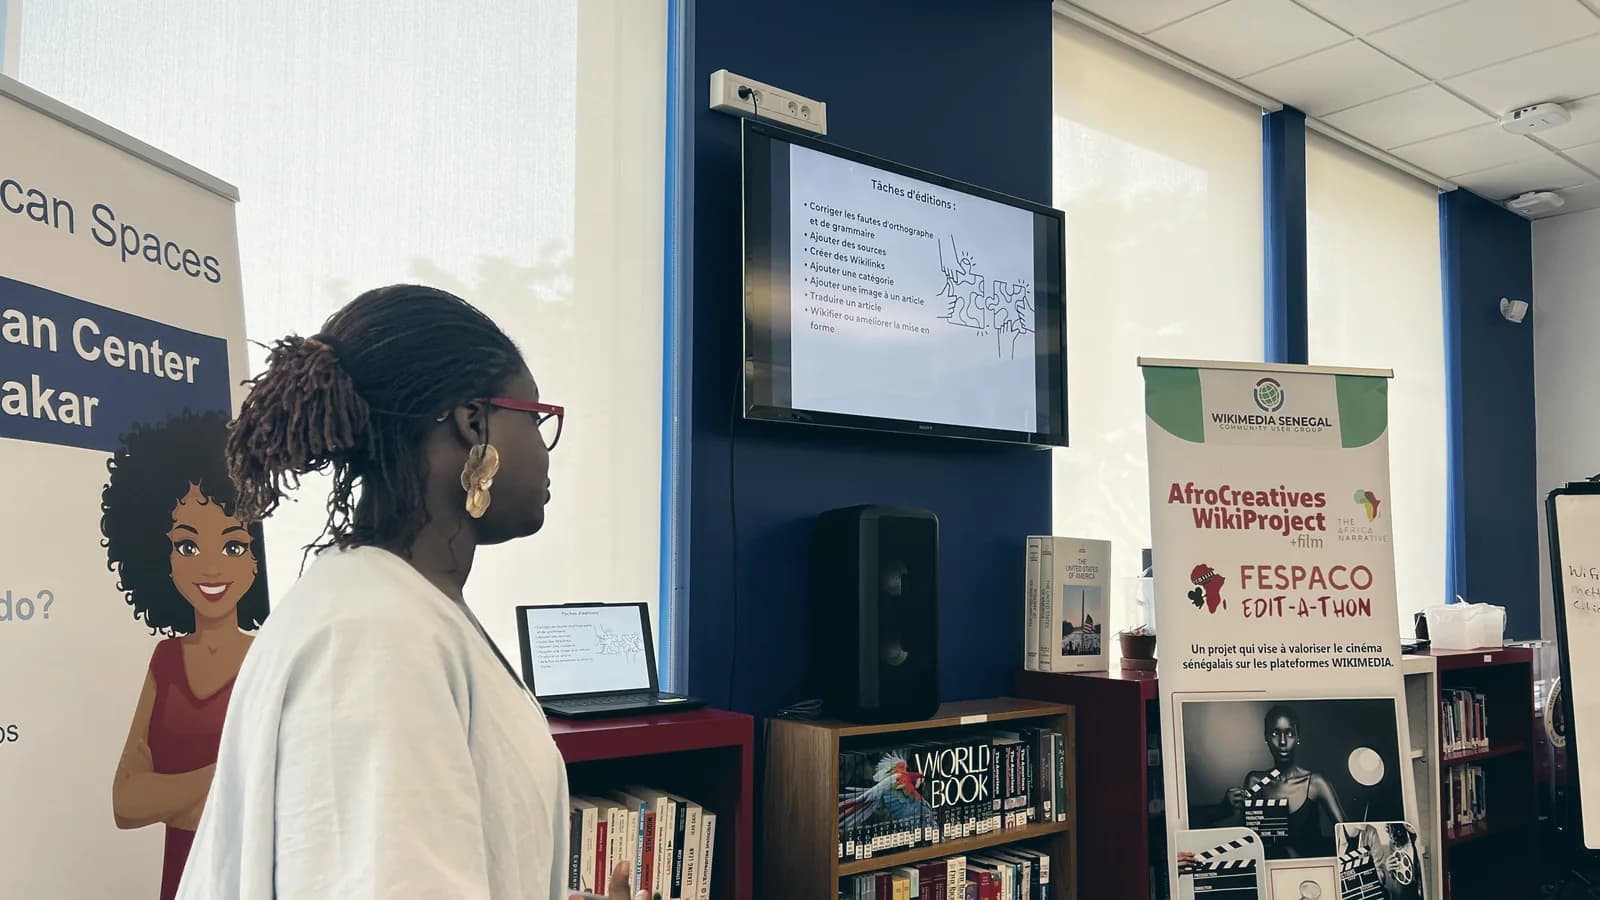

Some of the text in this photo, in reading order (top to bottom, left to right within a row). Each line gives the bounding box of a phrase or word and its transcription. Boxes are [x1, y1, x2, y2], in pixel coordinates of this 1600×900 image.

[871, 179, 904, 197] Tâches
[907, 189, 951, 209] d'éditions
[0, 179, 222, 284] can Spaces
[810, 202, 934, 239] Corriger les fautes d'orthographe
[820, 220, 830, 228] de
[832, 224, 875, 239] grammaire
[810, 232, 886, 256] Ajouter des sources
[810, 246, 885, 269] Créer des Wikilinks
[810, 262, 894, 285] Ajouter une catégorie
[810, 277, 840, 290] Ajouter
[842, 285, 857, 293] une
[858, 285, 882, 298] image
[884, 289, 889, 298] à
[902, 294, 924, 306] article
[810, 292, 844, 305] Traduire
[858, 301, 882, 312] article
[810, 307, 842, 320] Wikifier
[844, 313, 854, 321] ou
[856, 315, 892, 328] améliorer
[894, 321, 900, 330] la
[902, 323, 919, 333] mise
[810, 322, 835, 333] forme
[2, 308, 200, 384] an Center
[2, 374, 98, 427] akar
[1212, 413, 1332, 427] WIKIMEDIA SENEGAL
[1168, 482, 1326, 508] AfroCreatives
[1192, 508, 1326, 536] WikiProject
[1240, 565, 1373, 590] FESPACO
[1242, 596, 1372, 618] EDIT-A-THON
[1191, 643, 1382, 656] Un projet qui vise à valoriser le cinéma
[1183, 658, 1393, 671] sénégalais sur les plateformes WIKIMEDIA.
[915, 744, 990, 779] WORLD
[932, 774, 988, 809] BOOK
